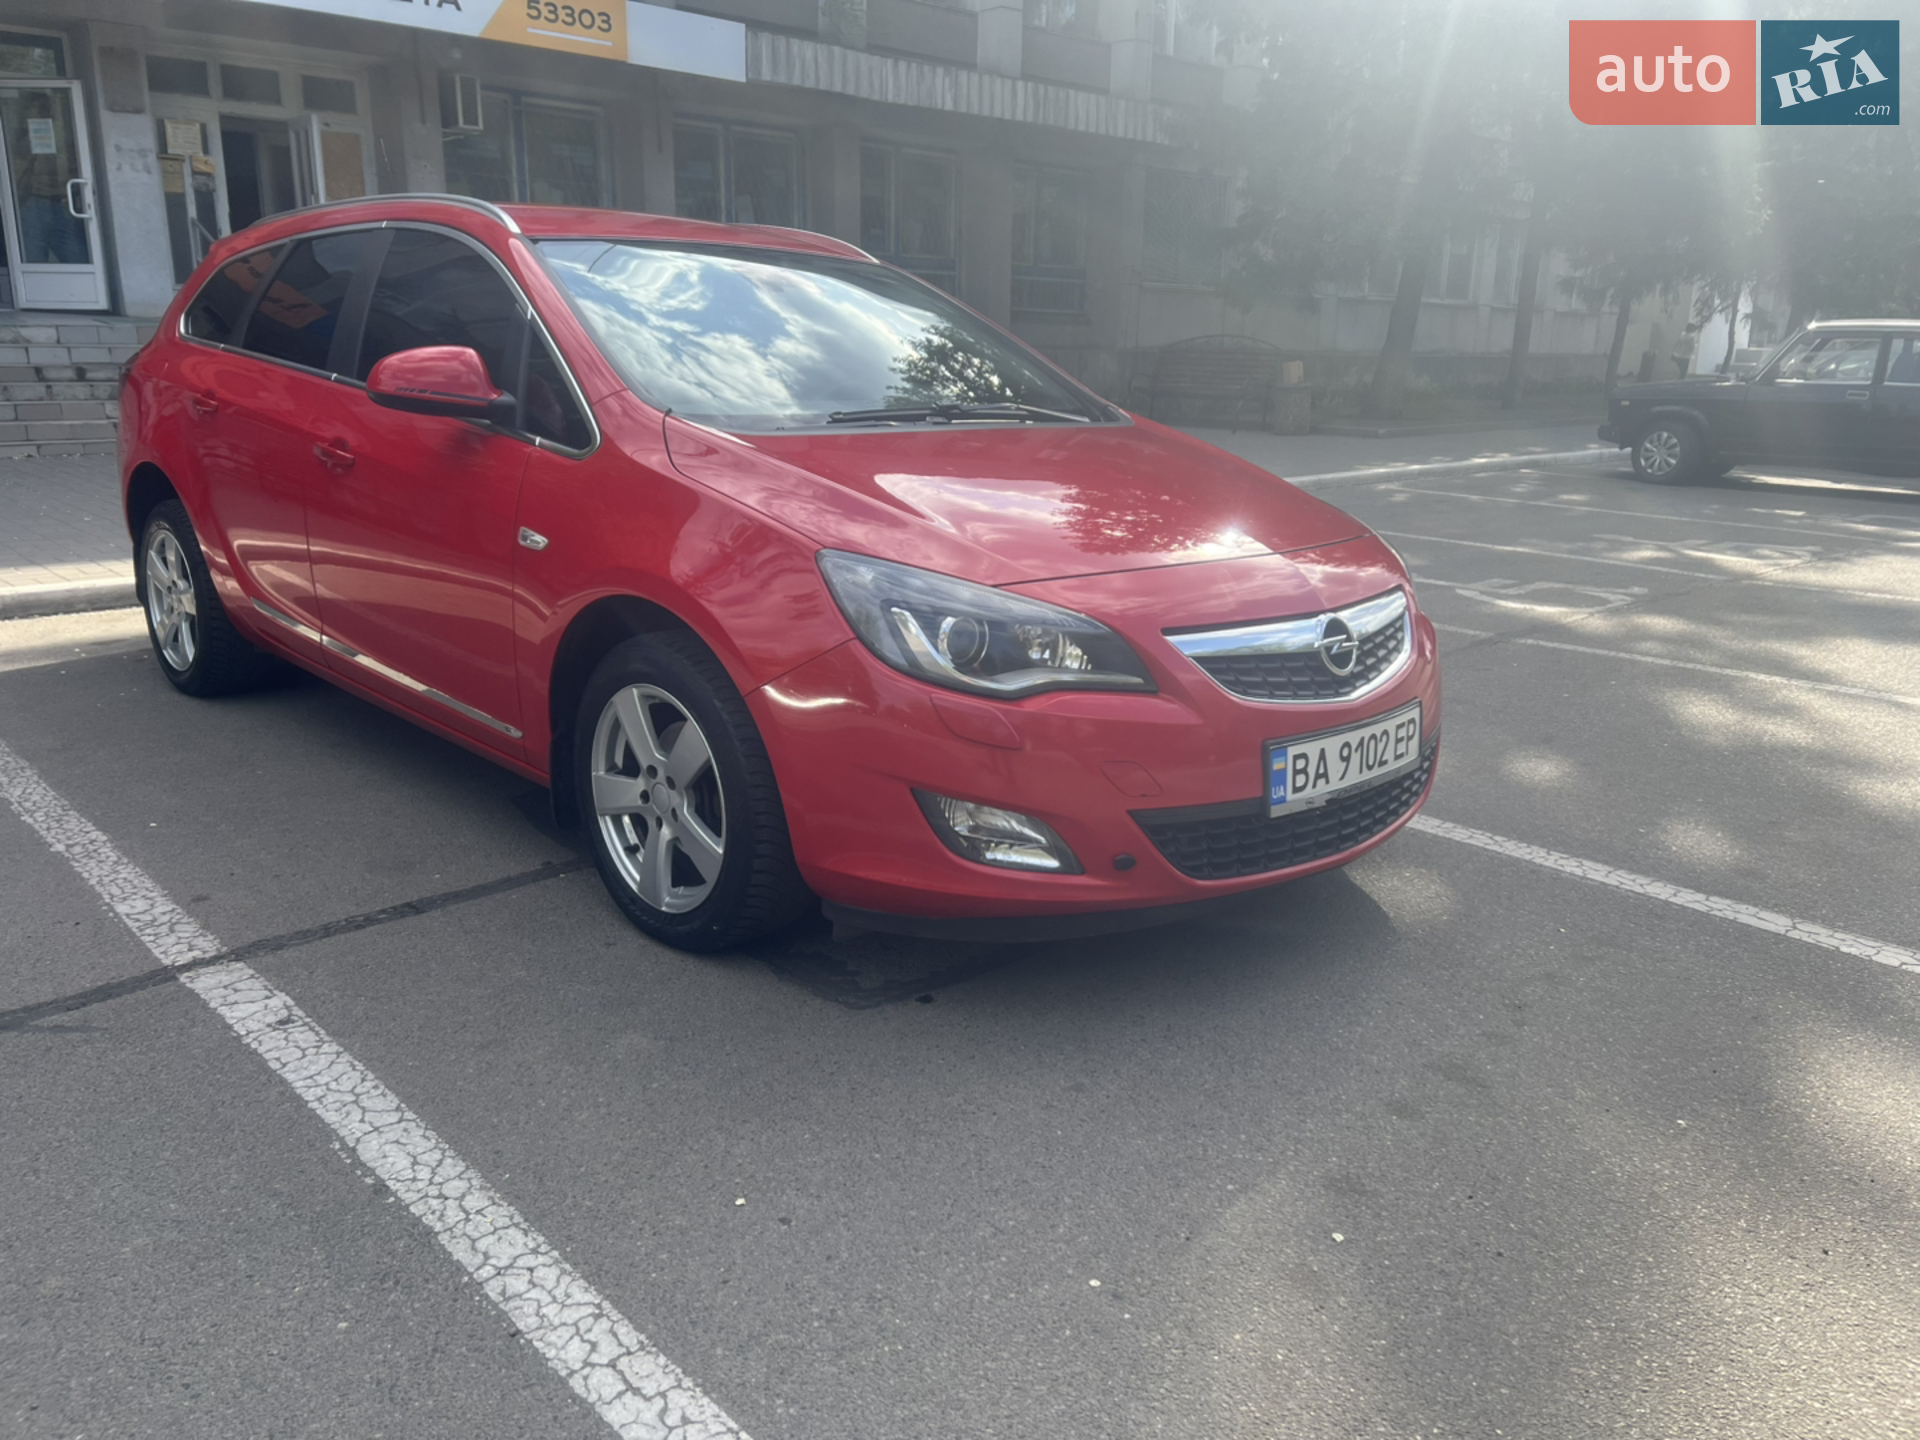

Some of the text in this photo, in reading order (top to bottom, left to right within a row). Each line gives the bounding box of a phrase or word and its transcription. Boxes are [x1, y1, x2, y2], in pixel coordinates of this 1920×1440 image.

[526, 0, 612, 33] 53303
[1292, 717, 1416, 794] BA 9102 EP
[1272, 786, 1285, 799] UA
